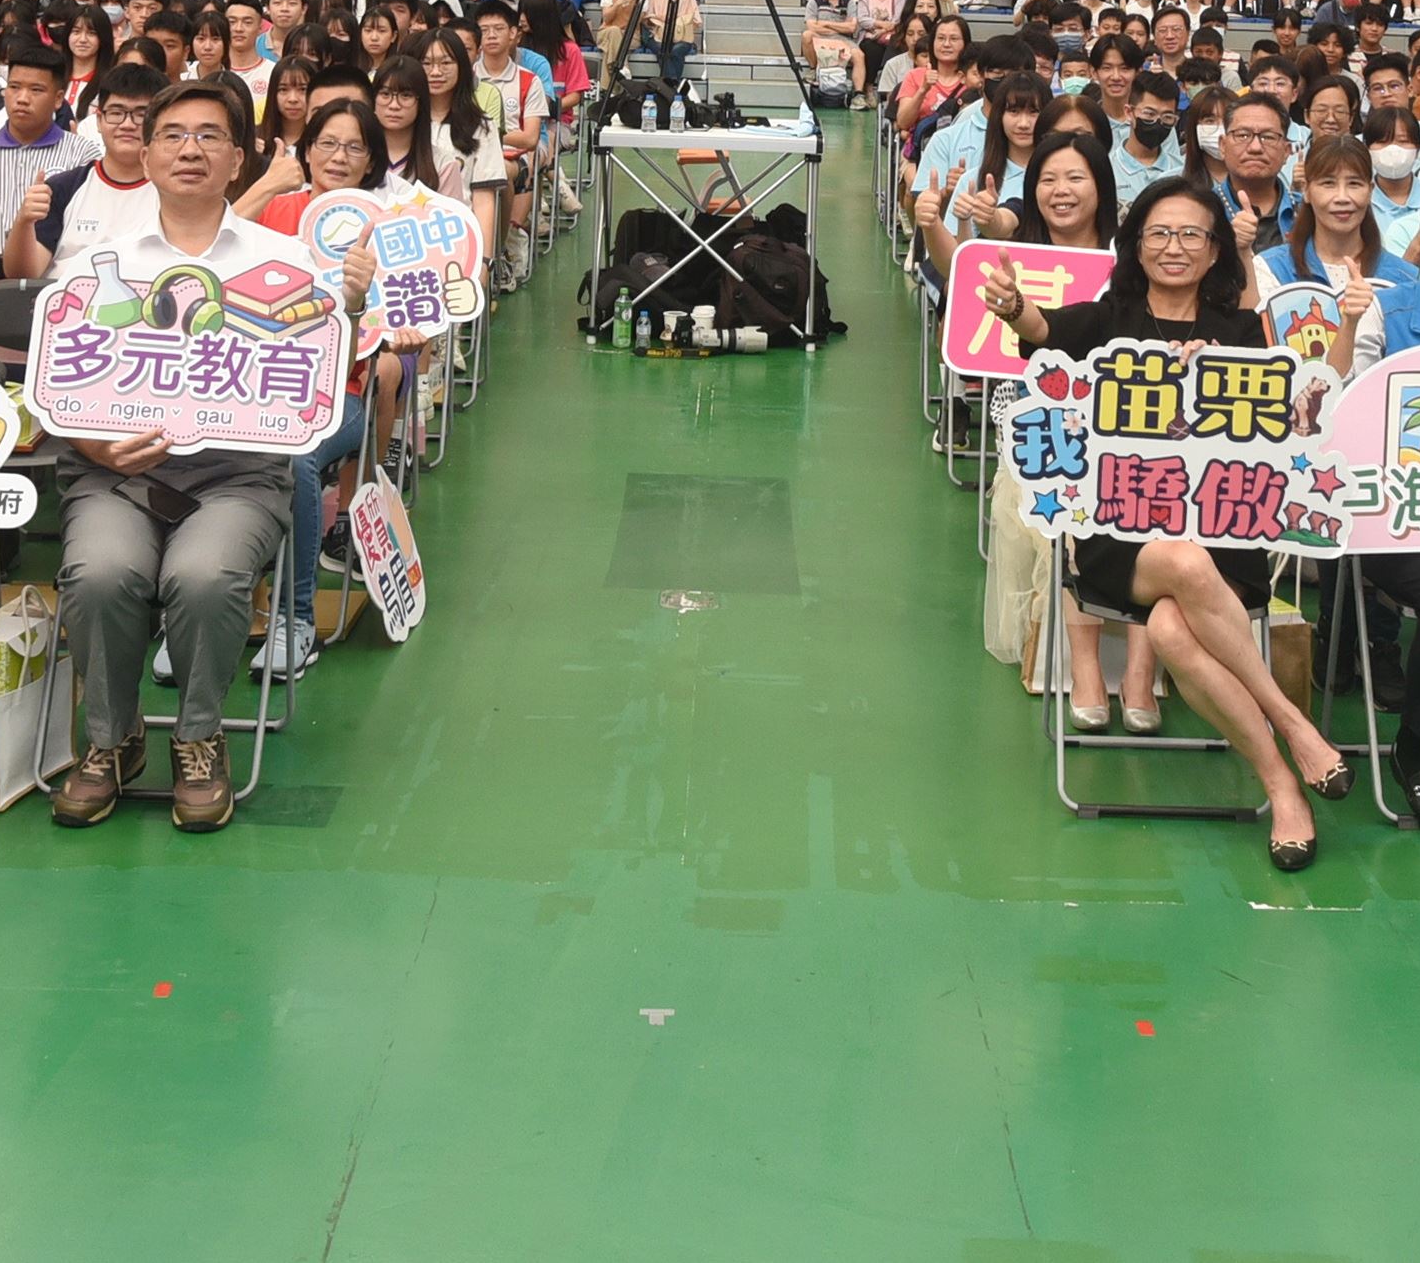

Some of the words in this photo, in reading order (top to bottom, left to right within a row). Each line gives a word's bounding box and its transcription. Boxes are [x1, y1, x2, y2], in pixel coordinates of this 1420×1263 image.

[374, 209, 465, 269] 國中
[383, 269, 441, 328] 讚
[48, 325, 321, 403] 多元教育
[1098, 352, 1289, 438] 苗栗
[1013, 407, 1089, 478] 我
[1097, 455, 1287, 538] 驕傲
